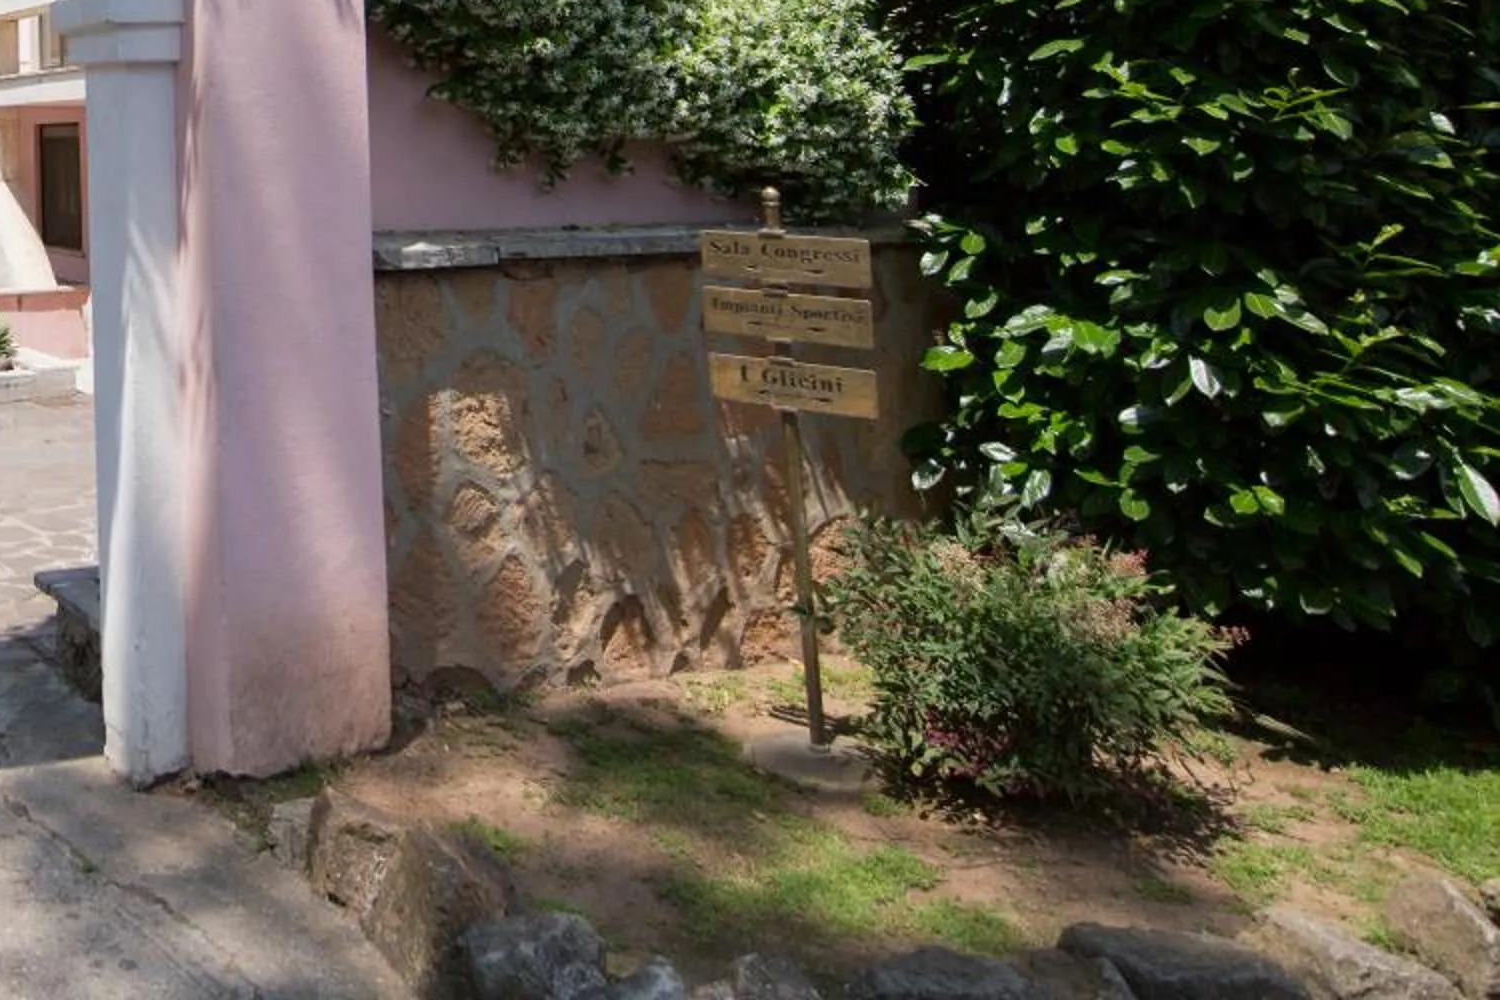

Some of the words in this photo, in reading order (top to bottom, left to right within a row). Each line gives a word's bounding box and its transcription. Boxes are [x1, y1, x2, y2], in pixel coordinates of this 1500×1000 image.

[709, 240, 750, 257] Sala
[759, 243, 861, 264] Congressi
[740, 364, 750, 383] I
[761, 366, 845, 394] Glicini
